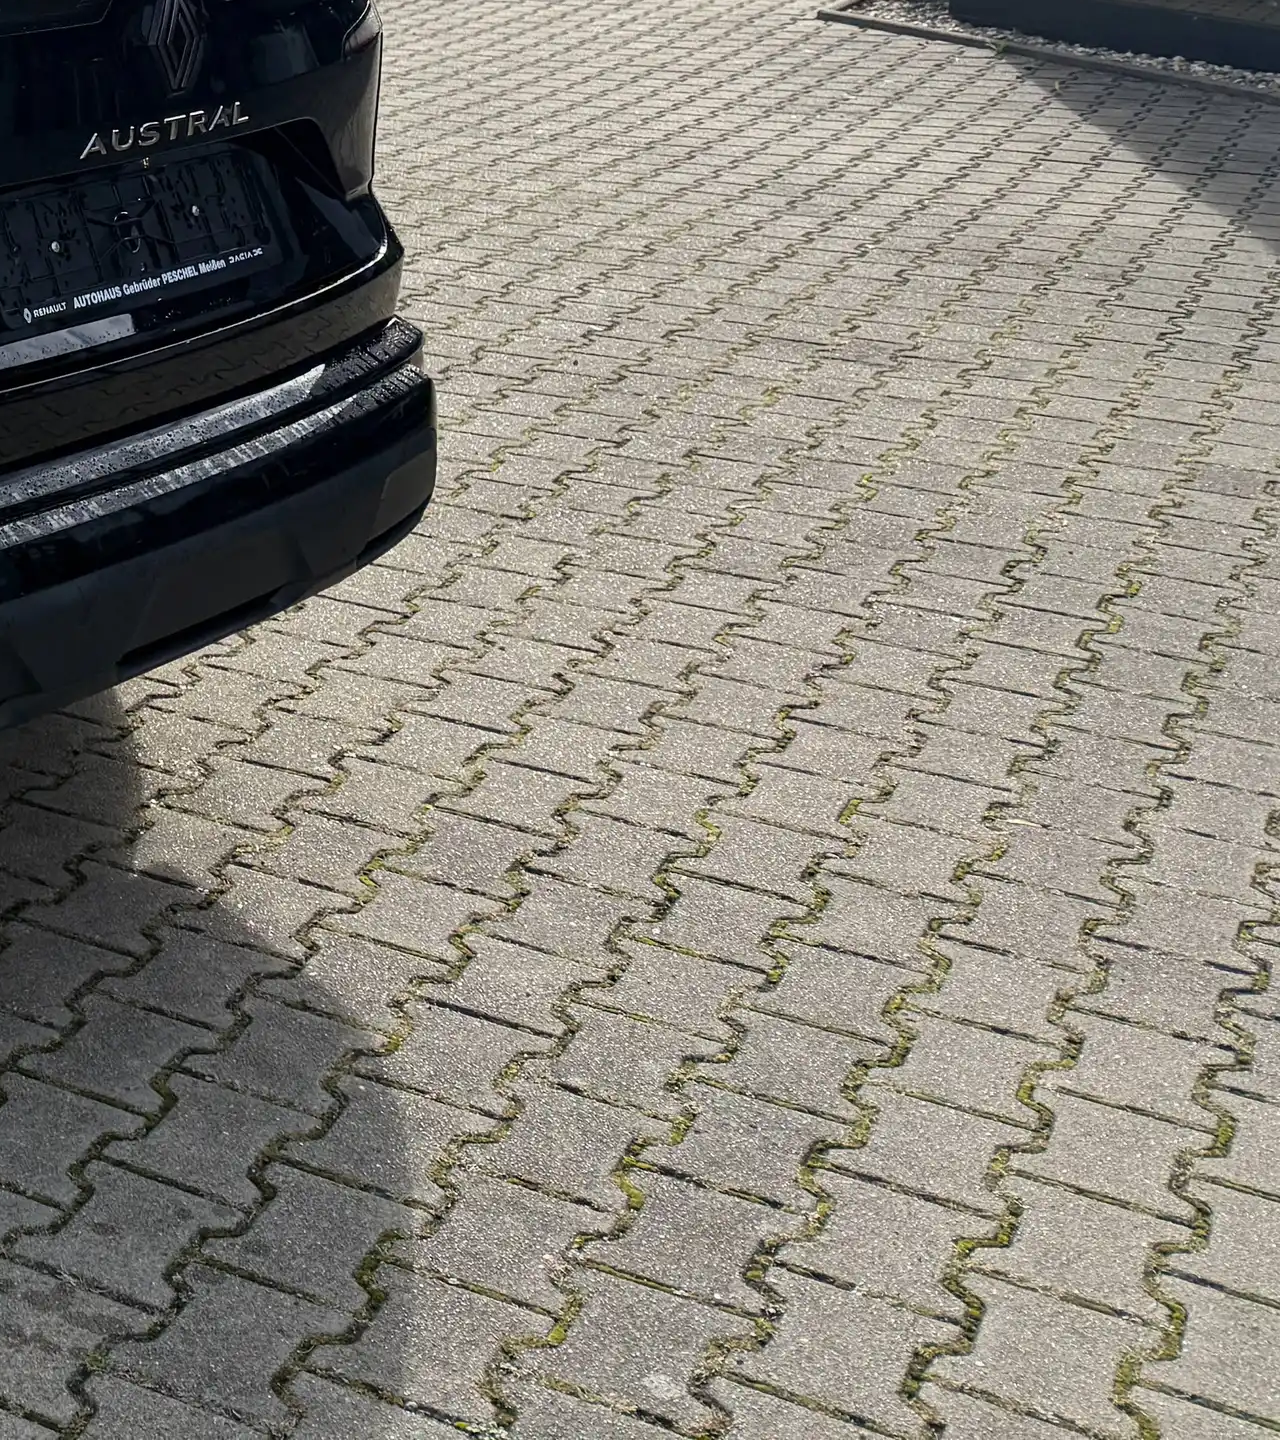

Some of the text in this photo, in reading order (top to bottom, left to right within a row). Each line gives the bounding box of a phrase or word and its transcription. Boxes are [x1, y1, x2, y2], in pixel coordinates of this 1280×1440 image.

[79, 101, 249, 159] AUSTRAL
[33, 301, 67, 318] RENAULT
[73, 285, 122, 309] AUTOHAUS
[122, 276, 161, 295] Gebrüder
[160, 265, 199, 285] PESCHEL
[198, 259, 227, 275] Meißen
